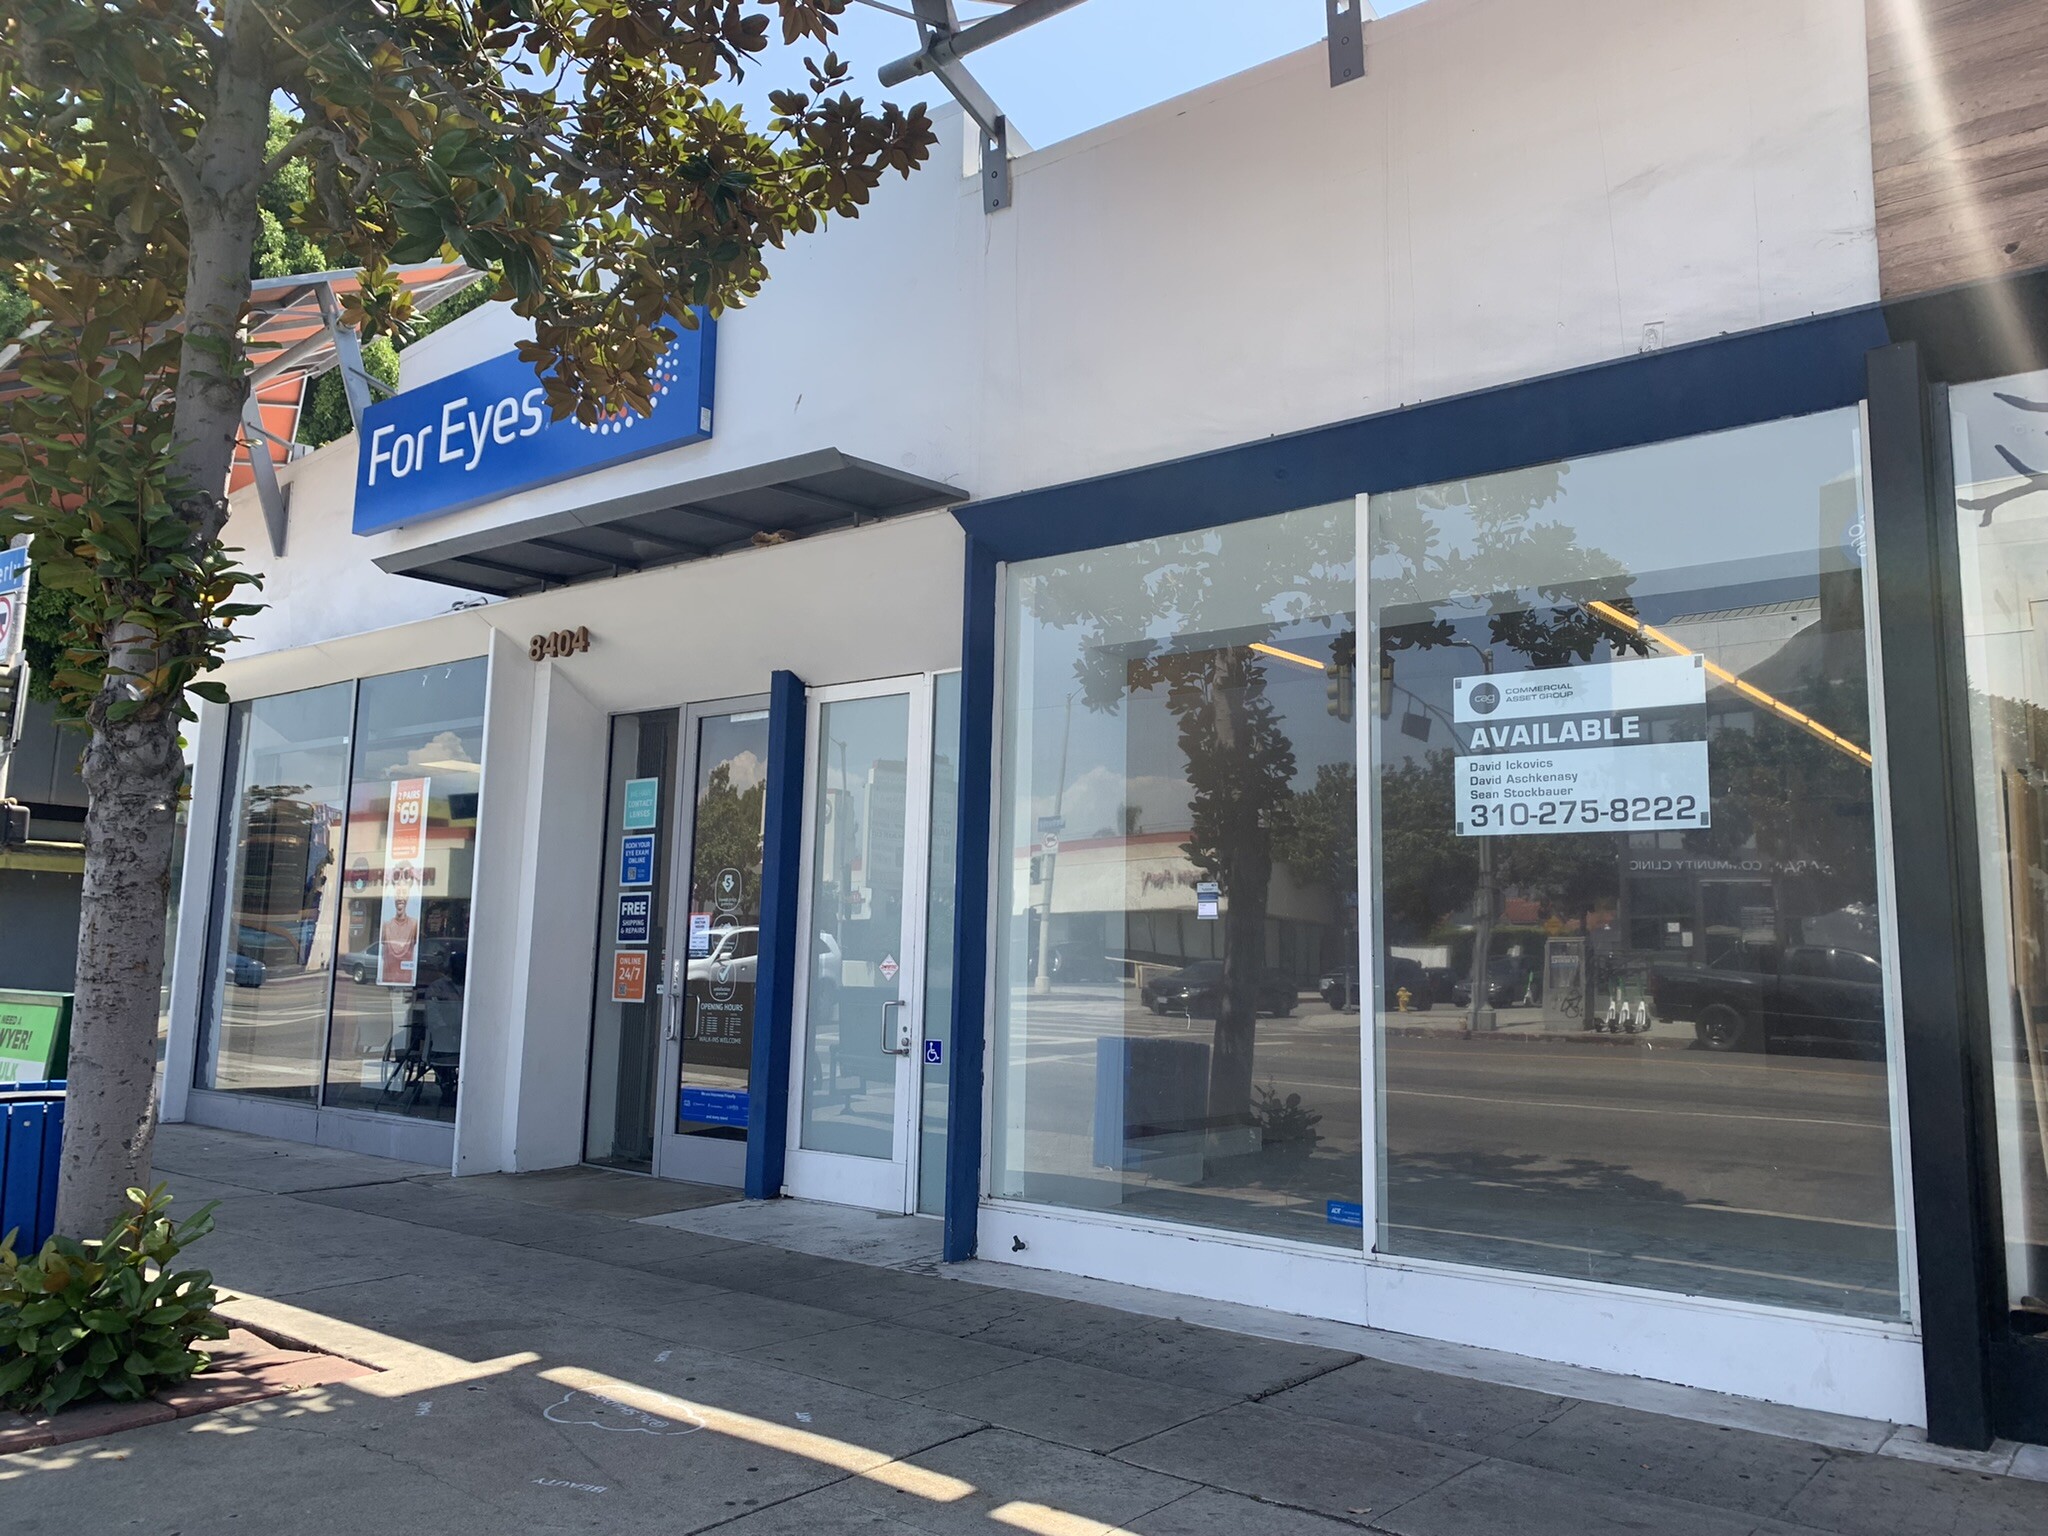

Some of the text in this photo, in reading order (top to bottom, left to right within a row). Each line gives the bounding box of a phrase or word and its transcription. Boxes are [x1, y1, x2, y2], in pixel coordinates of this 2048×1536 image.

[368, 387, 544, 487] For Eyes
[528, 625, 590, 662] 8404
[1505, 683, 1573, 695] COMMERCIAL
[1506, 691, 1574, 703] ASSET GROUP
[1469, 715, 1640, 750] AVAILABLE
[1470, 758, 1554, 772] David Ickovics
[1470, 773, 1578, 786] David Aschkenasy
[402, 790, 421, 800] PAIRS
[1470, 787, 1574, 800] Sean Stockbauer
[628, 799, 653, 809] CONTACT
[397, 801, 419, 825] $69
[629, 809, 651, 819] LENSES
[1470, 795, 1697, 828] 310-275-8222
[627, 856, 646, 864] ONLINE
[621, 901, 647, 916] FREE
[622, 919, 645, 927] SHIPPING
[625, 926, 646, 934] REPAIRS
[619, 957, 641, 965] ONLINE
[618, 966, 641, 982] 24/7
[700, 1002, 744, 1012] OPENING HOURS
[530, 1477, 608, 1494] BEAUTY
